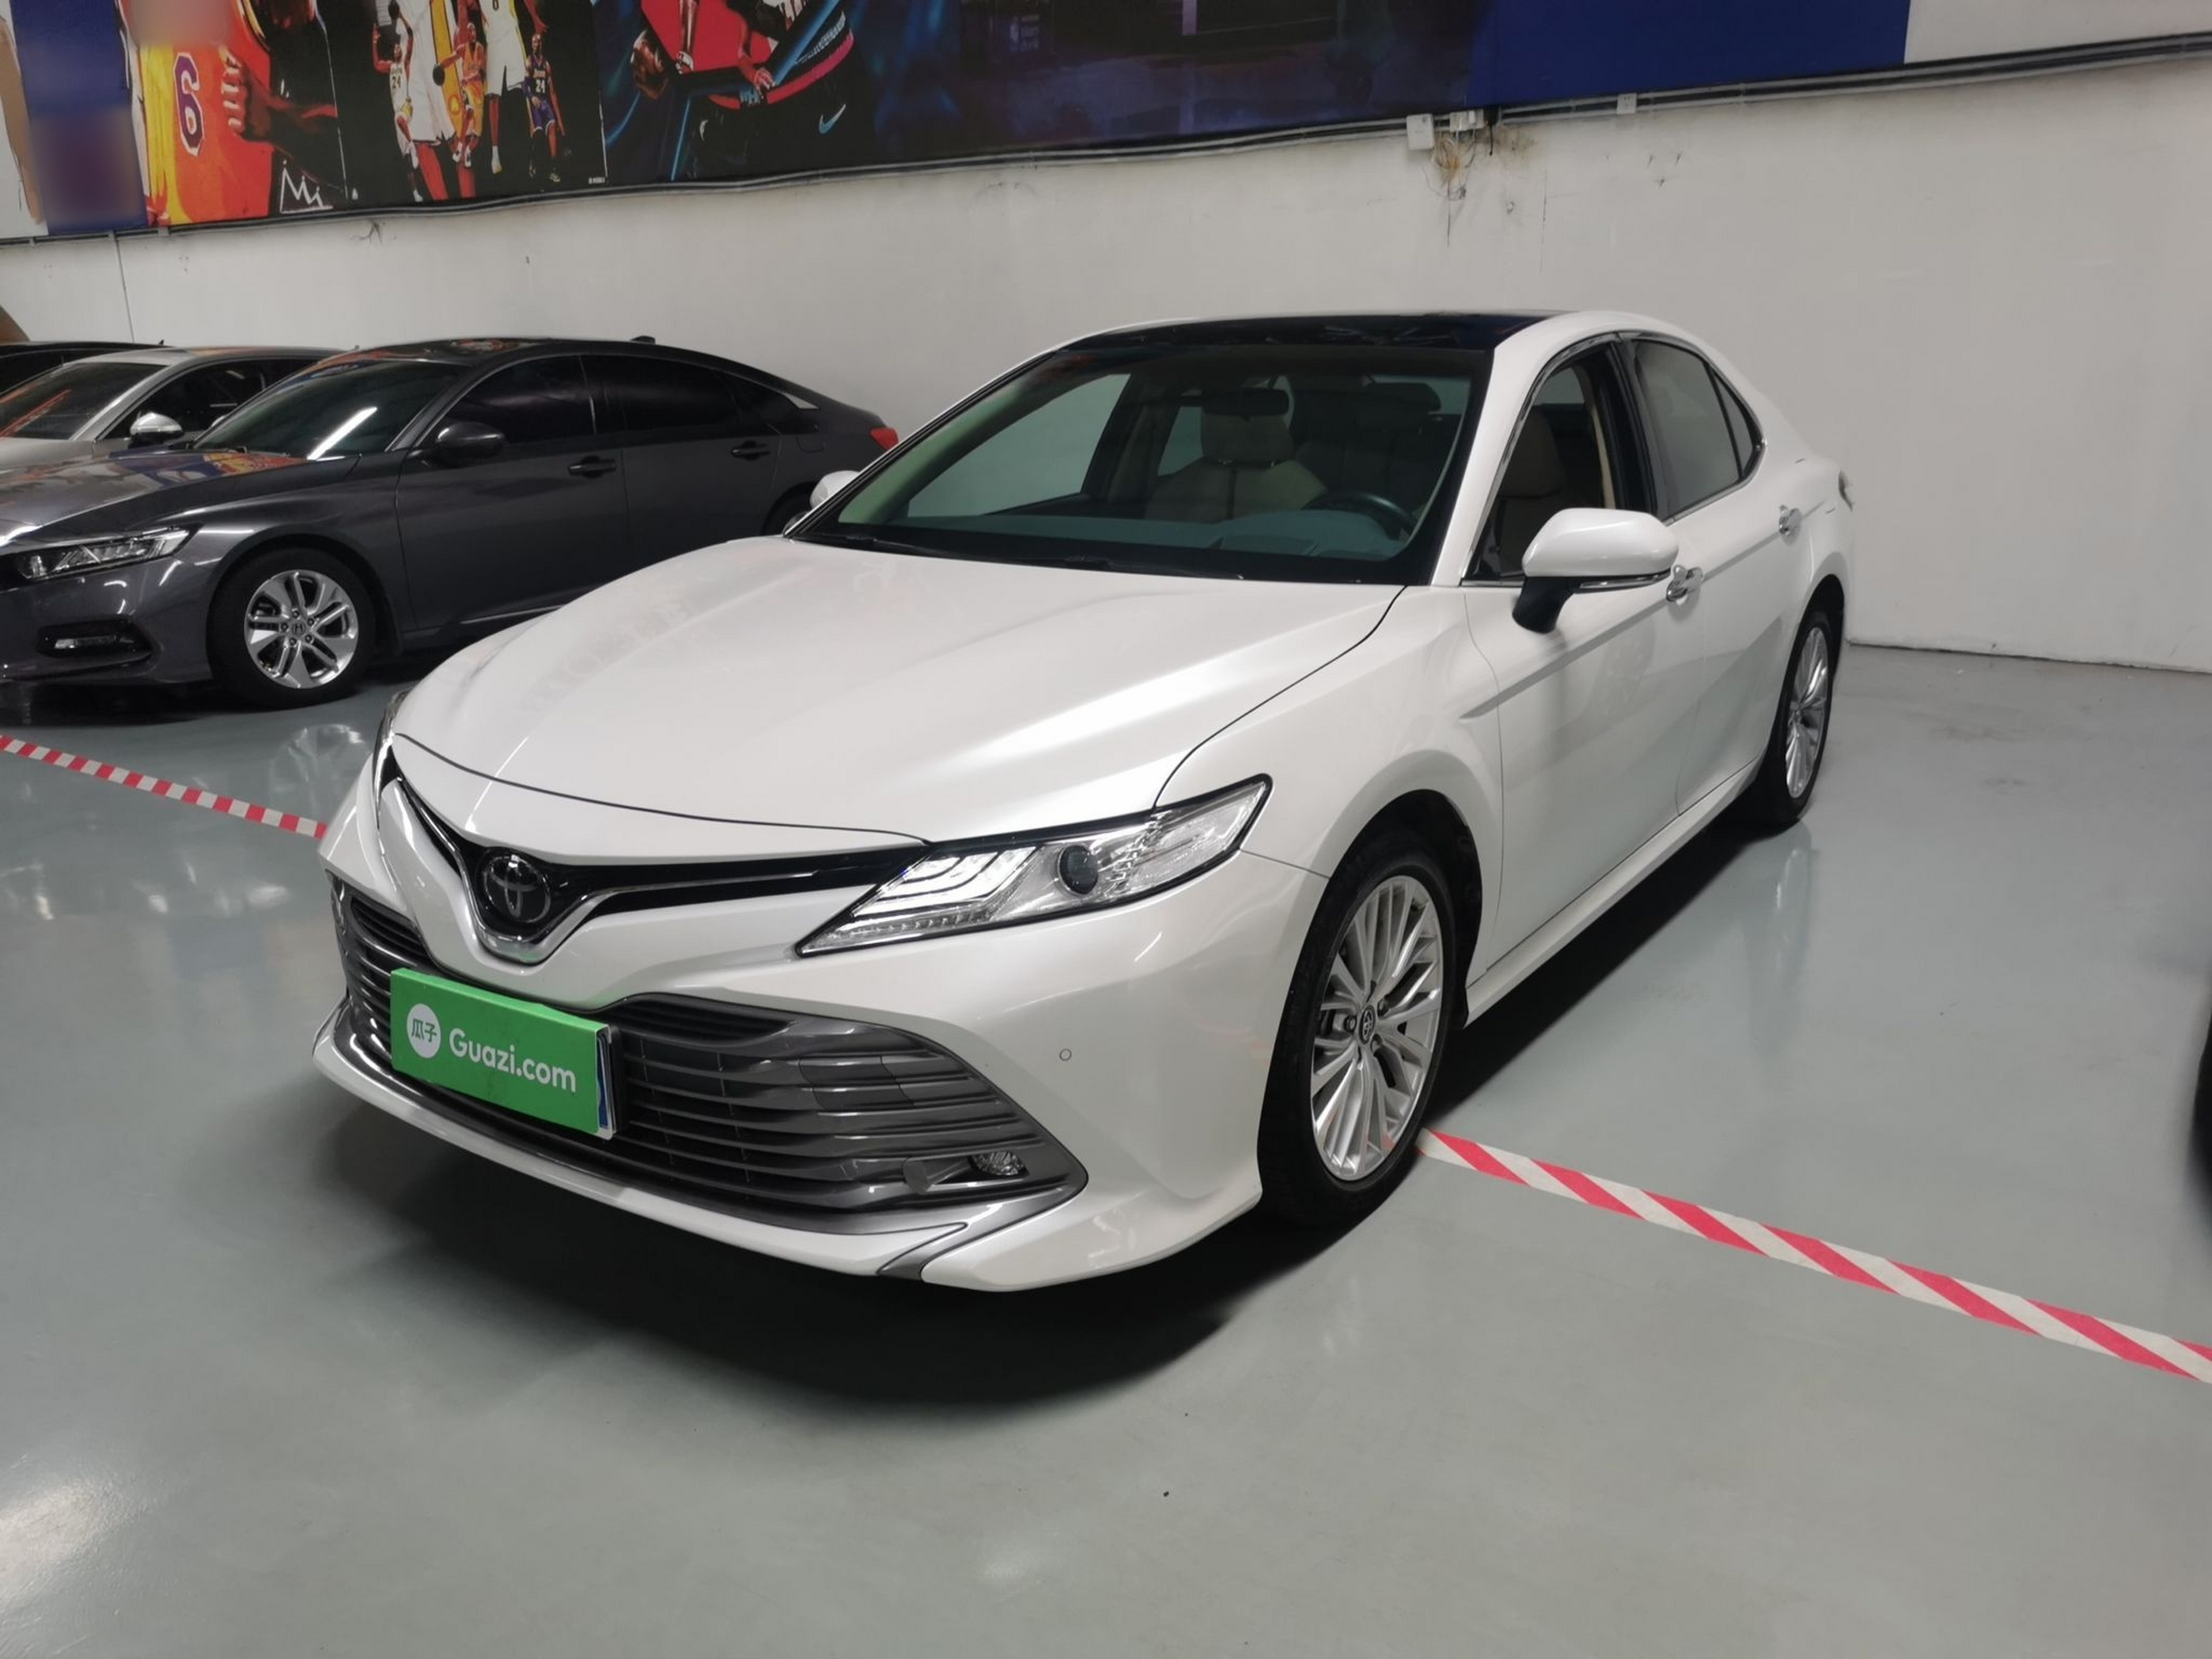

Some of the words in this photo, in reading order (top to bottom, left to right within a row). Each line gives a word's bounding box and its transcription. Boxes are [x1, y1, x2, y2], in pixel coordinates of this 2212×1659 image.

[392, 75, 402, 88] 24
[536, 79, 546, 93] 24
[173, 52, 203, 156] 6
[412, 1018, 437, 1043] 瓜子
[449, 1028, 577, 1093] Guazi.com
